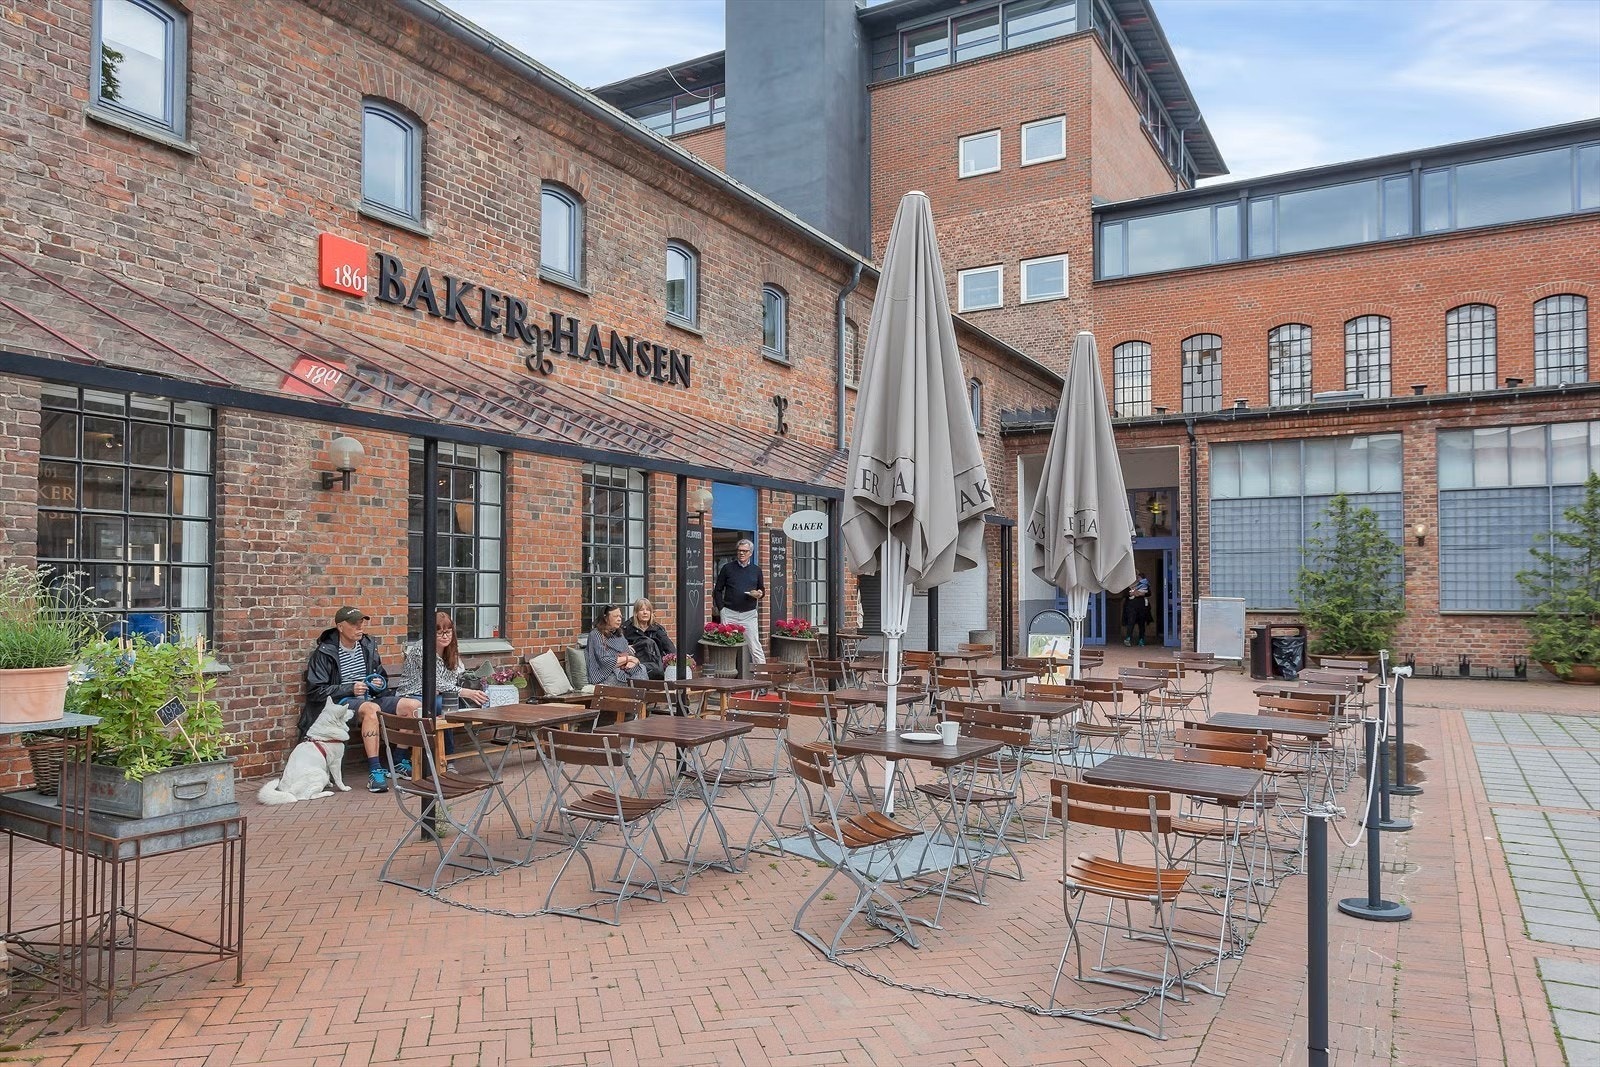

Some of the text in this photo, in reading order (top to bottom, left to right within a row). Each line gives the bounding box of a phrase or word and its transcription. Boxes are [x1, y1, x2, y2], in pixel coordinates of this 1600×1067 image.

[334, 264, 368, 293] 1861
[375, 252, 692, 388] BAKER HANSEN
[854, 468, 880, 497] ER
[791, 521, 824, 531] BAKER
